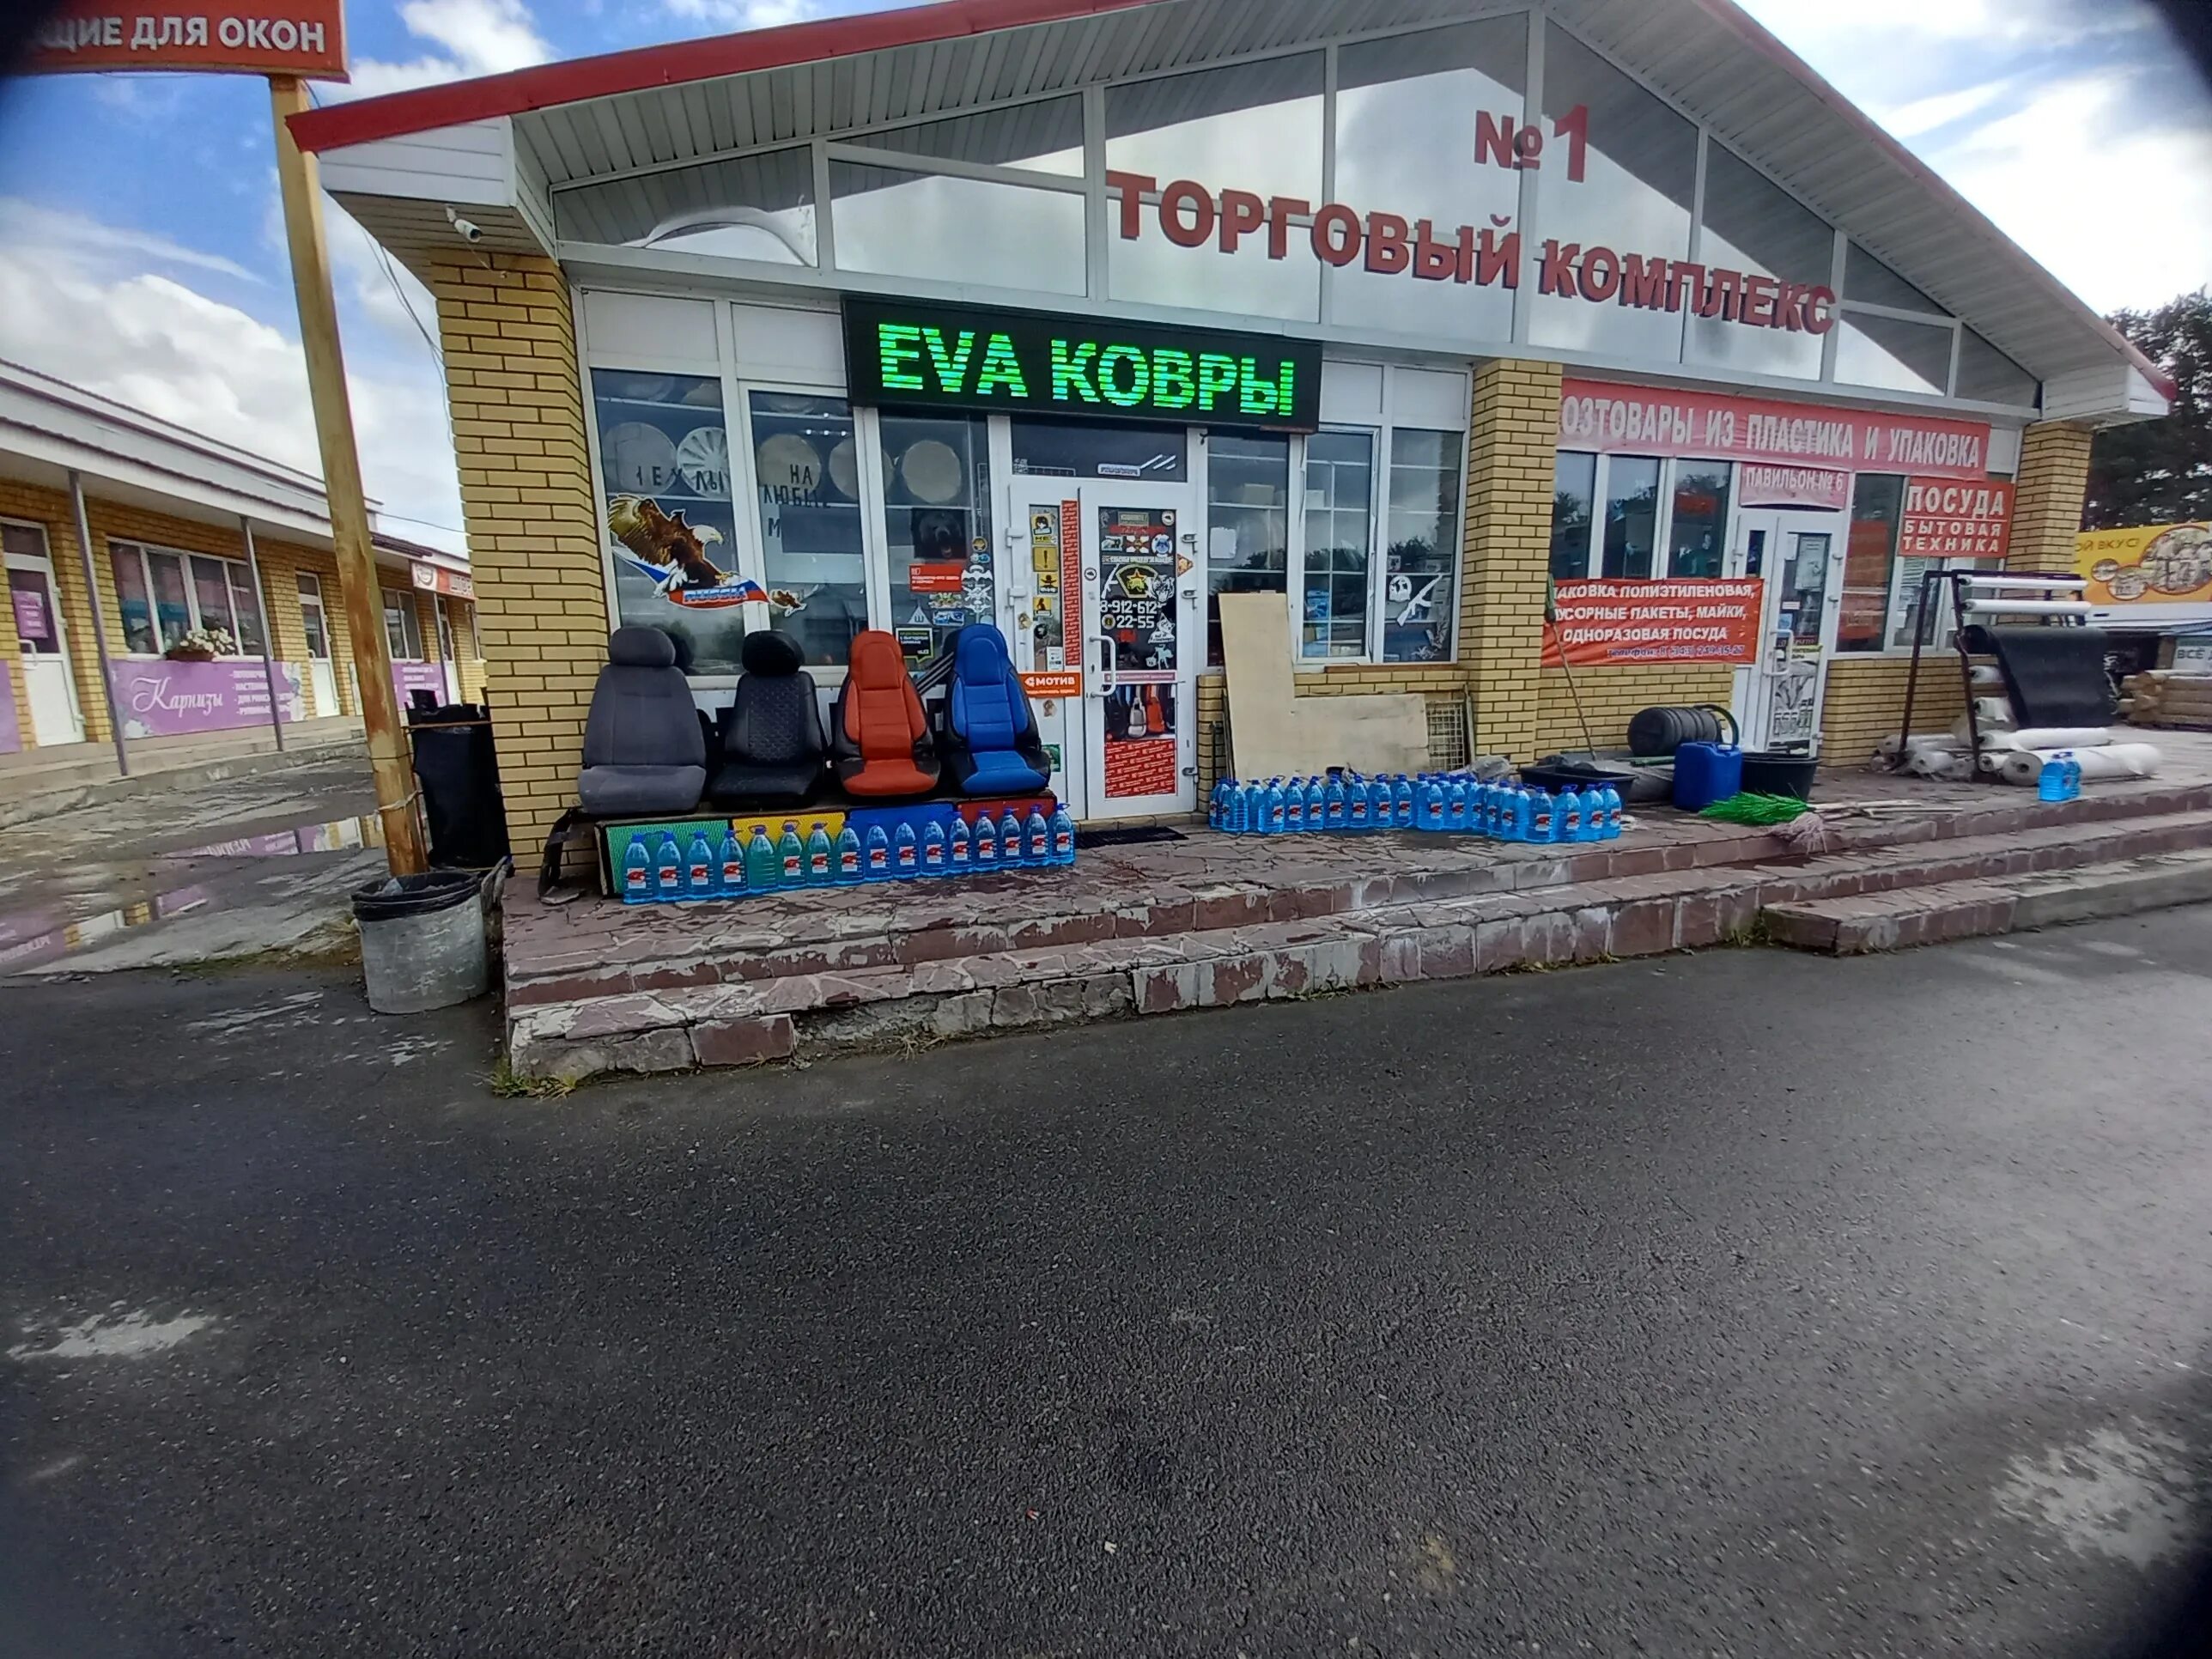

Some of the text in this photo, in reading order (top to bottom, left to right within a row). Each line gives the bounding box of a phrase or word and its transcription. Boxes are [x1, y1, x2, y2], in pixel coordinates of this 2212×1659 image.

[130, 16, 208, 52] ДЛЯ
[218, 18, 325, 53] ОКОН
[1553, 102, 1588, 184] 1
[1104, 168, 1838, 336] ТОРГОВЫЙ КОМПЛЕКС
[878, 322, 1296, 416] EVA КОВРЫ
[1561, 395, 1979, 468] ОЗТОВАРЫ ИЗ ПЛАСТИКА И УПАКОВКА
[789, 464, 813, 486] НА
[1746, 466, 1817, 490] ПАВИЛЬОН
[1905, 484, 2005, 520] ПОСУДА
[1904, 520, 2002, 537] БЫТОВАЯ
[1902, 536, 2000, 553] ТЕХНИКА
[1619, 584, 1755, 599] ПОЛИЭТИЛЕНОВАЯ,
[1116, 615, 1155, 629] 22-55
[1631, 605, 1694, 621] ПАКЕТЫ,
[1696, 602, 1747, 621] МАЙКИ,
[1562, 626, 1728, 644] ОДНОРАЗОВАЯ ПОСУДА
[1036, 677, 1075, 686] МОТИВ
[131, 676, 223, 718] Карнизы
